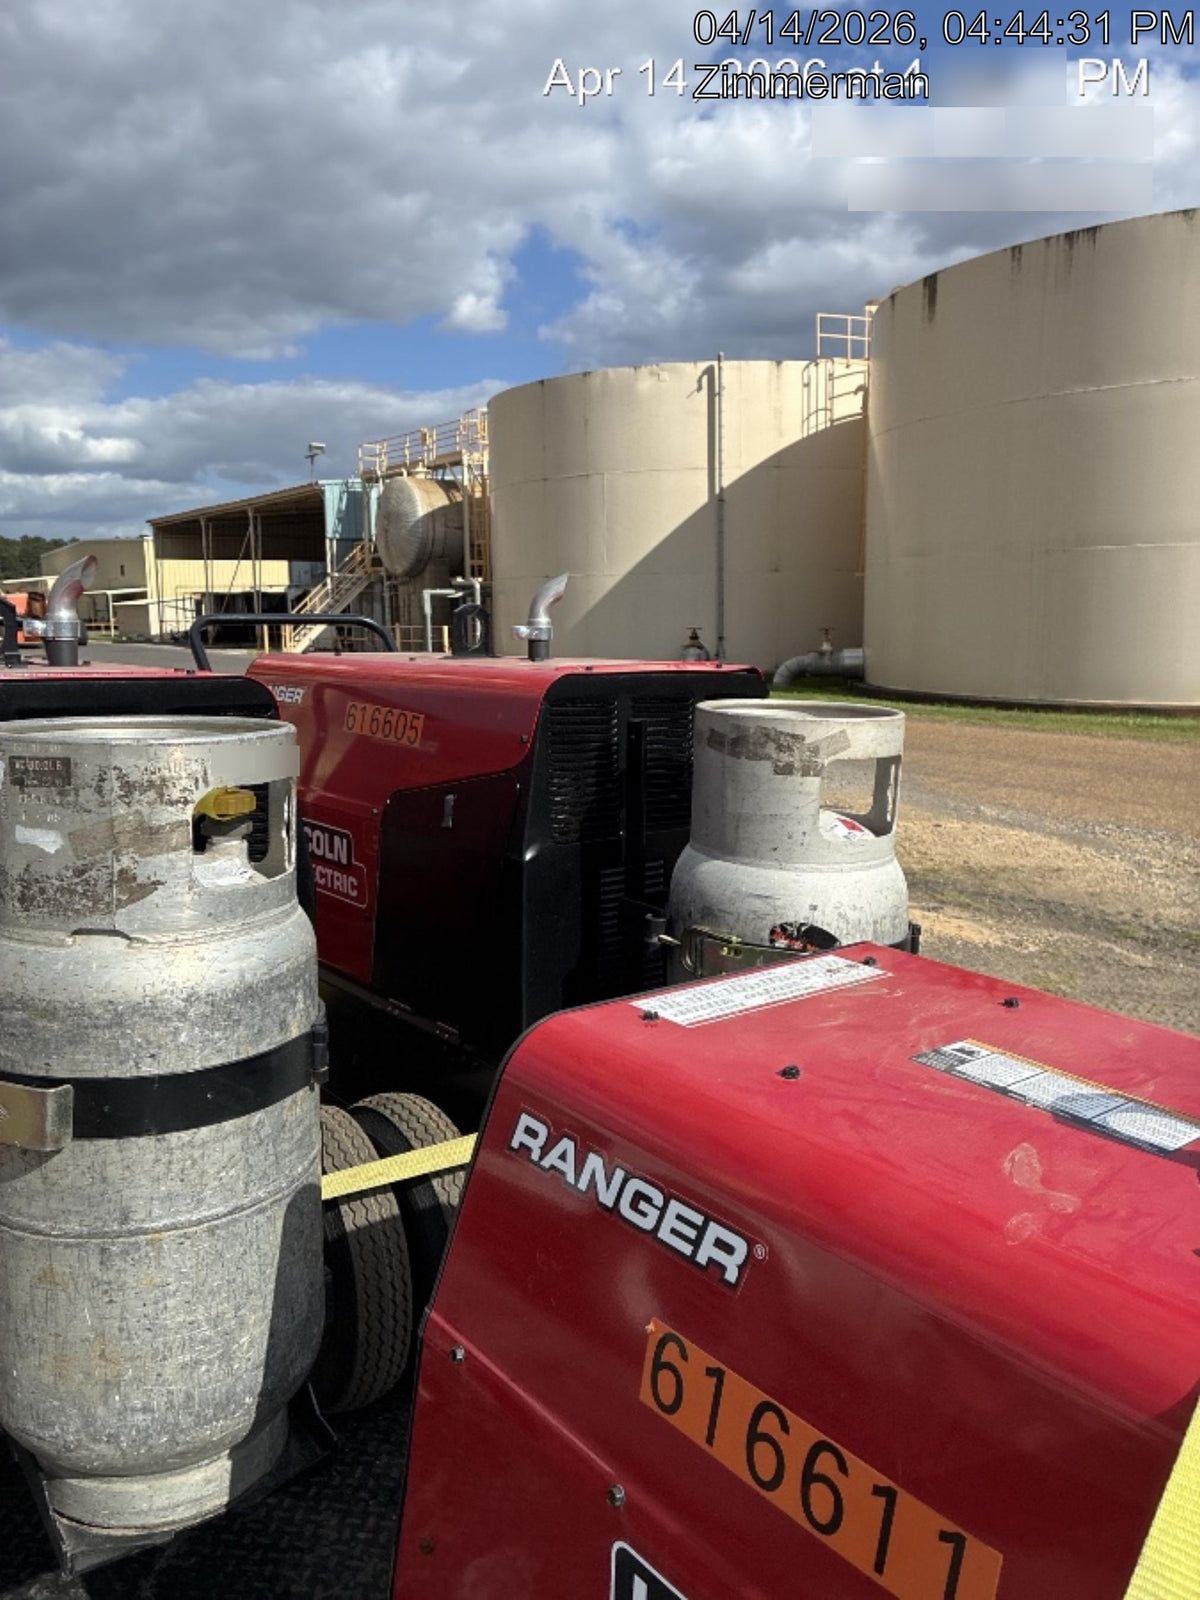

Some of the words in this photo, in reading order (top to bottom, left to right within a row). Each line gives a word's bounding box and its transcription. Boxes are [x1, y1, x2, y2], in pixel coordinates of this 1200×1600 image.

[345, 703, 421, 745] 616605
[313, 863, 358, 897] CTRIC
[649, 1332, 969, 1600] 616611
